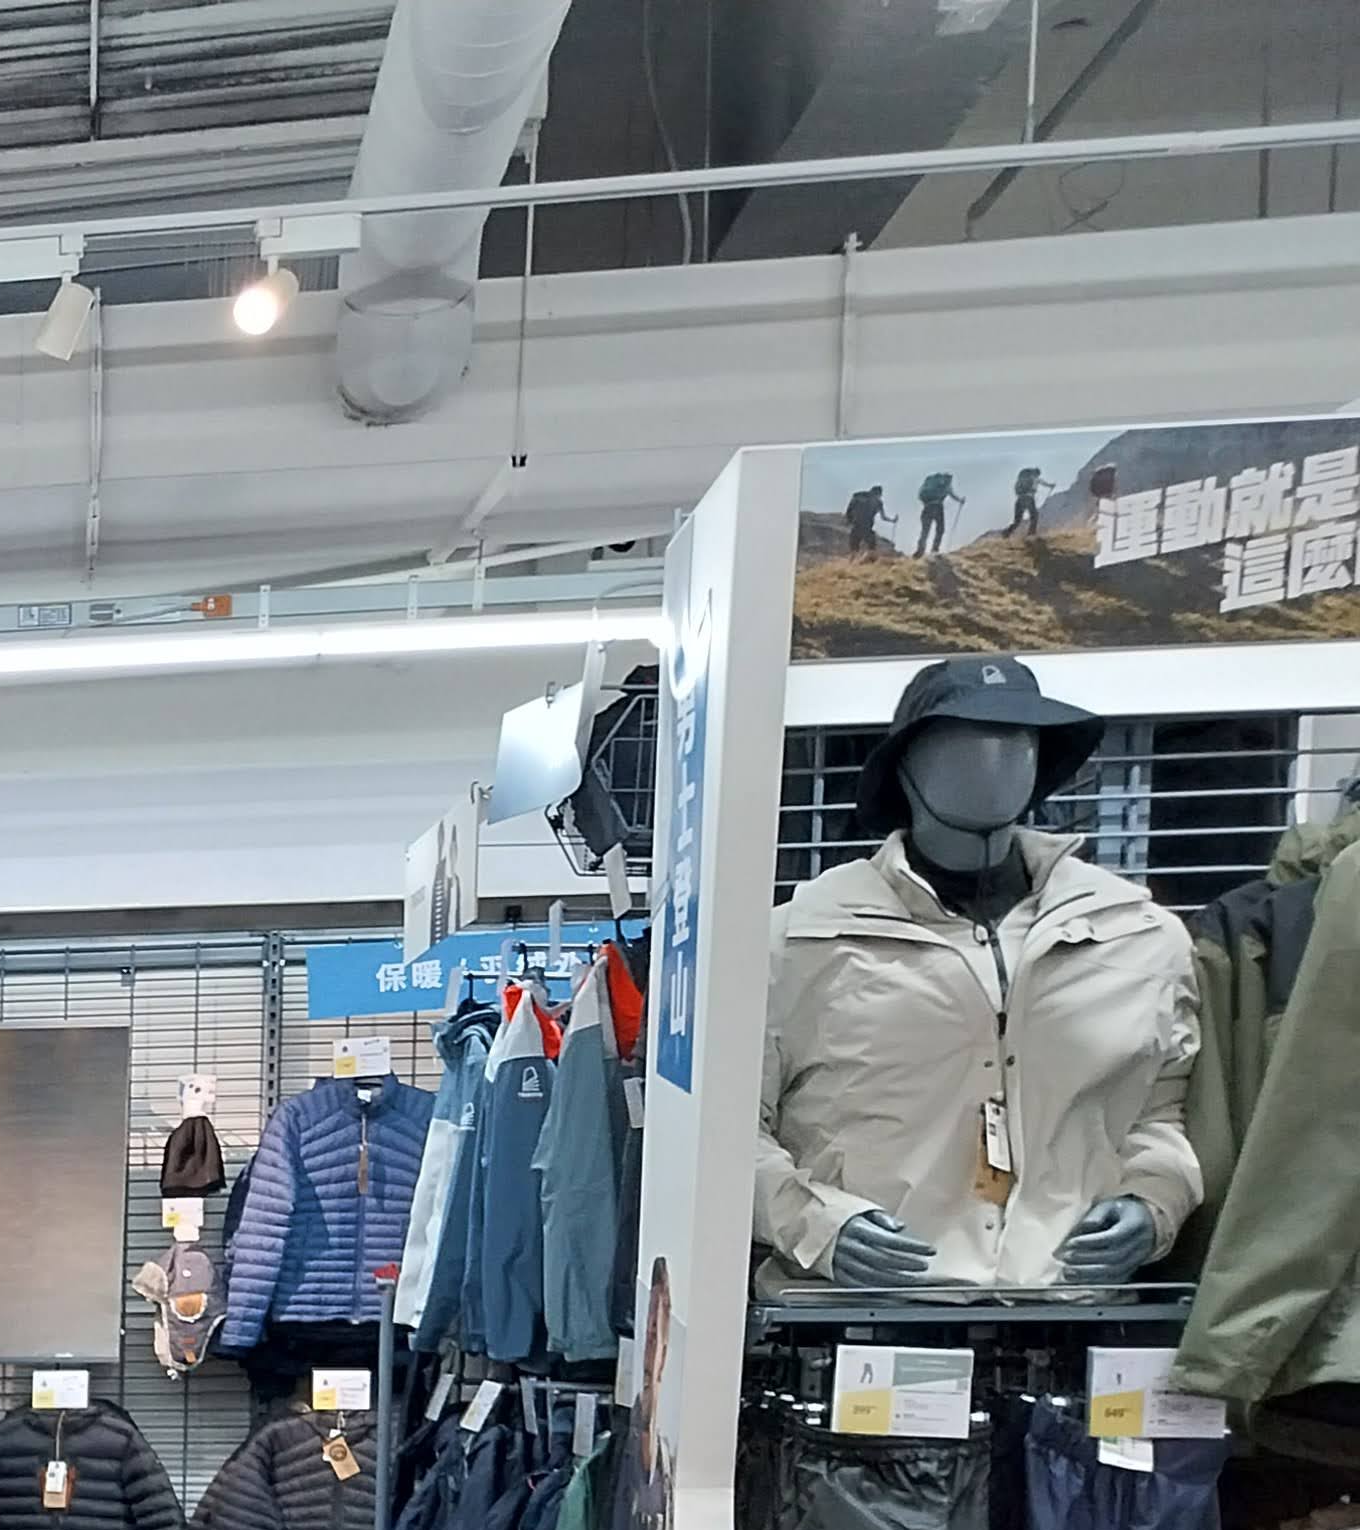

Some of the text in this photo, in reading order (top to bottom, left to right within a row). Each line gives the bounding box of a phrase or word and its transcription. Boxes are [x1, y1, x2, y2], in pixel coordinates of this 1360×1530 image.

[1094, 446, 1360, 568] 運動就是
[1220, 521, 1360, 613] 這麼
